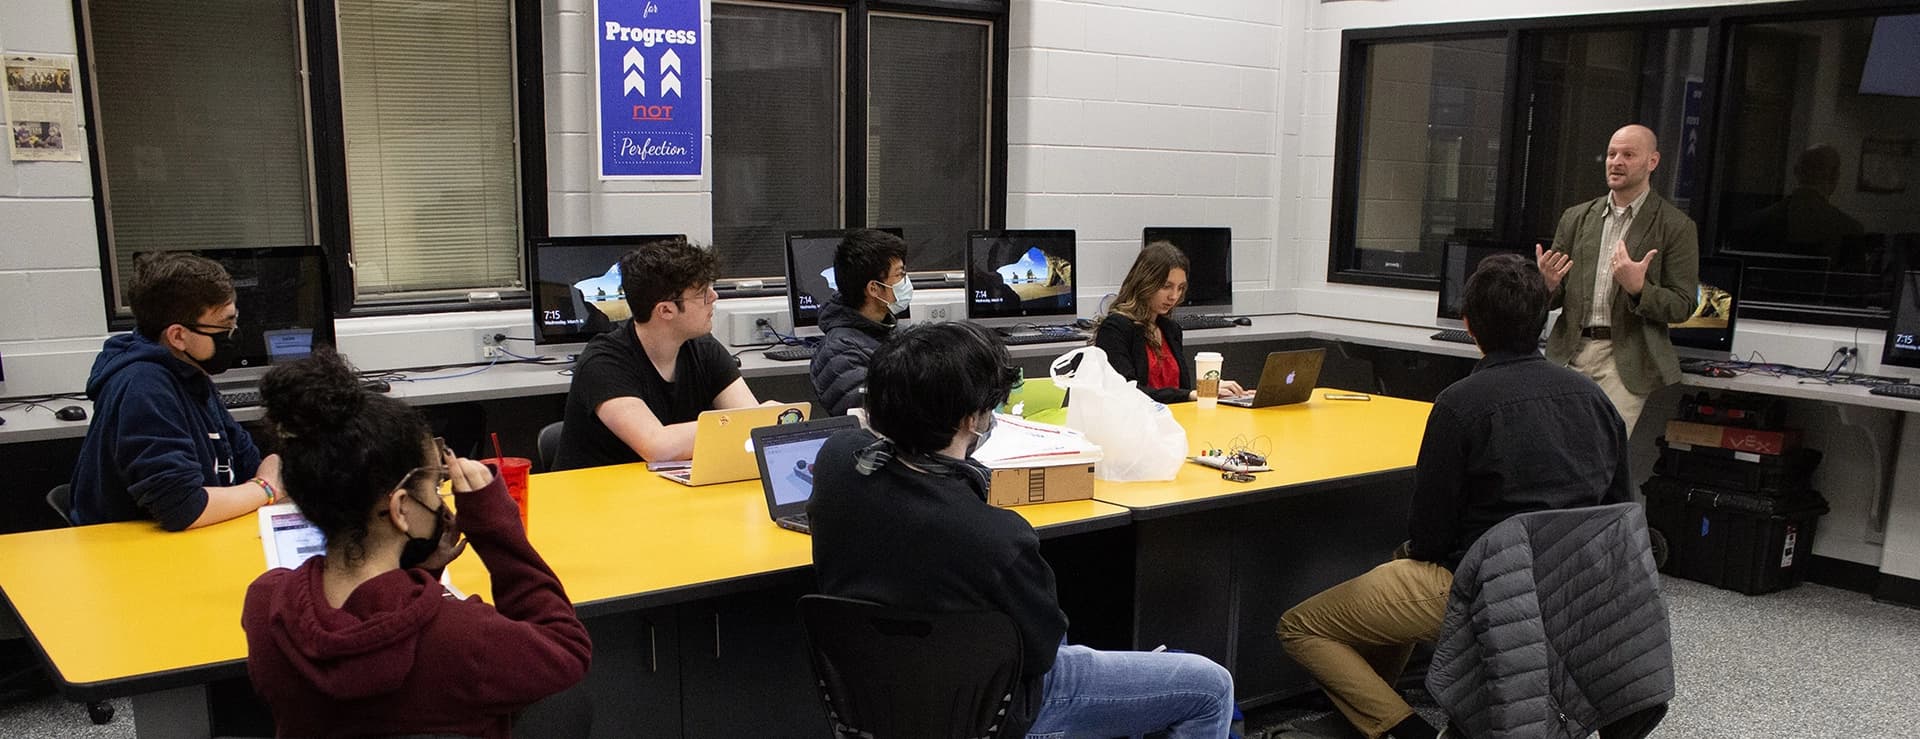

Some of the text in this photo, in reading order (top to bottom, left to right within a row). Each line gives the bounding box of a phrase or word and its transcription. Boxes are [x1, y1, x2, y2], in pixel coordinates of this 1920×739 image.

[643, 1, 658, 18] for
[605, 21, 696, 47] Progress
[620, 137, 687, 160] Perfection
[543, 310, 561, 320] 7:15
[1896, 334, 1913, 345] 7:15
[1730, 435, 1771, 452] VEX
